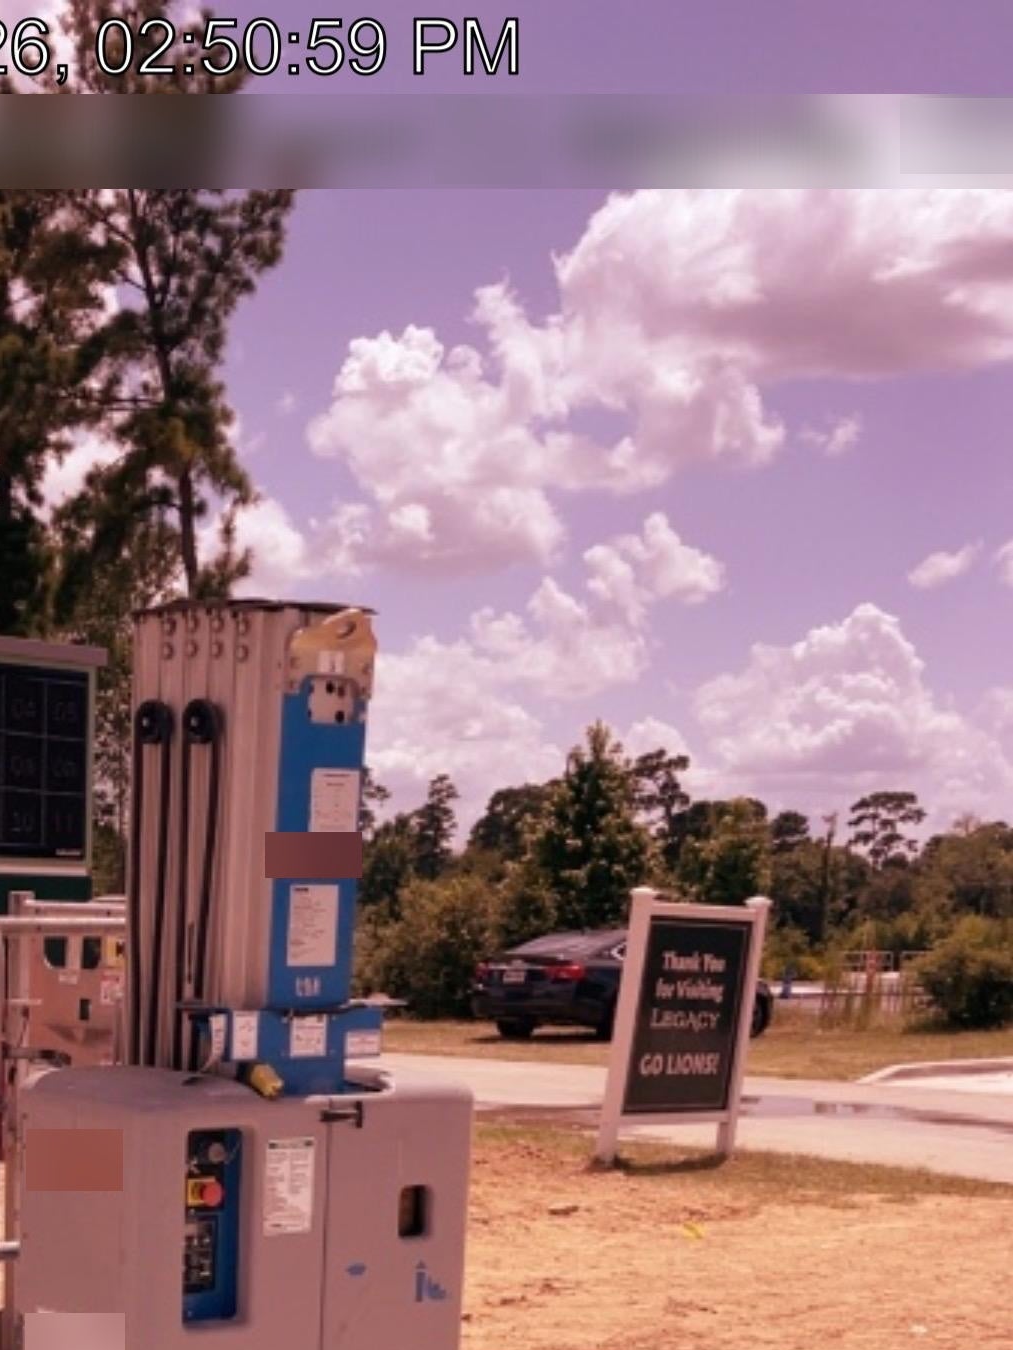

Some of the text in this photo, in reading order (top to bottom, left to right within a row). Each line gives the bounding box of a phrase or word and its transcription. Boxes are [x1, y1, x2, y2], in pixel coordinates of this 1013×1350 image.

[662, 950, 726, 973] Thank You
[656, 977, 723, 1003] for Visiting
[650, 1008, 720, 1031] LEGACY
[641, 1052, 719, 1076] GO LIONS!
